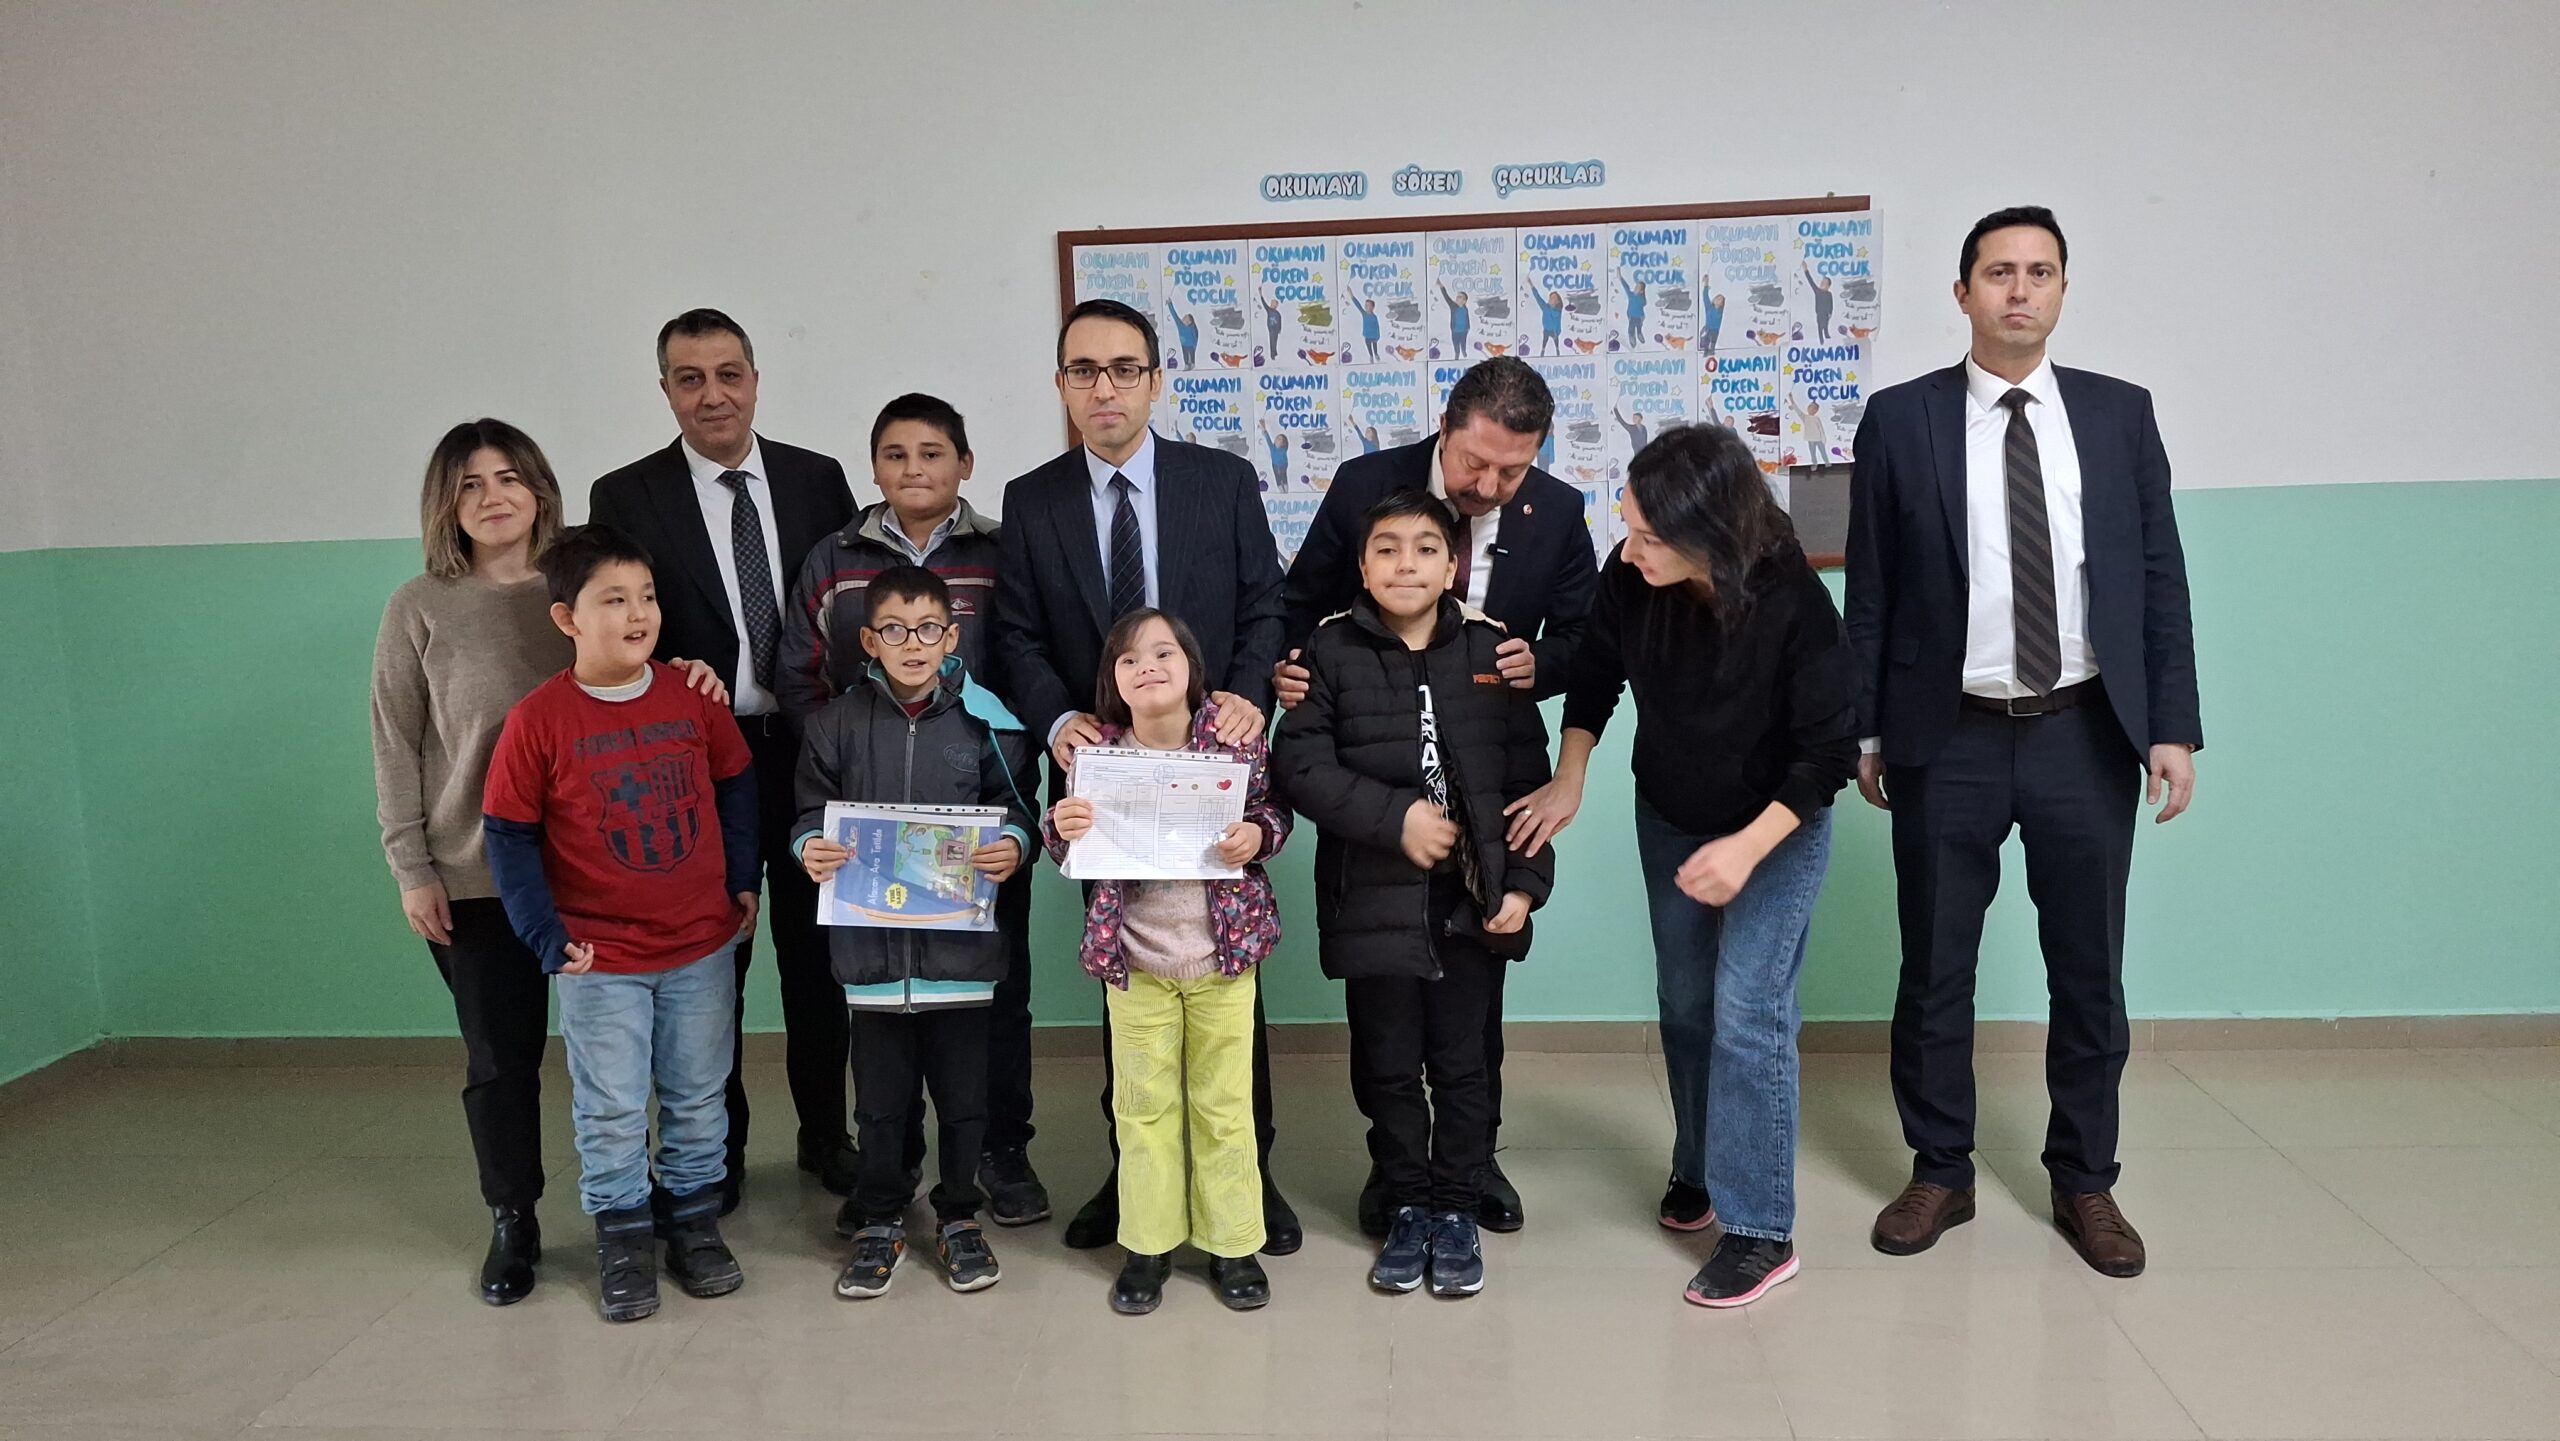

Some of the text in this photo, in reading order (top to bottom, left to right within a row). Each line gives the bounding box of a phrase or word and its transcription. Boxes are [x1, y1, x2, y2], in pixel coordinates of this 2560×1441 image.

[1264, 163, 1603, 199] OKUMAYI SÖKEN ÇOCUKLAR
[1613, 228, 1687, 247] OKUMAYI
[1705, 223, 1780, 242] OKUMAYI
[1798, 218, 1872, 238] OKUMAYI
[1343, 240, 1414, 259] OKUMAYI
[1432, 236, 1504, 255] OKUMAYI
[1523, 232, 1596, 251] OKUMAYI
[1804, 238, 1854, 259] SÖKEN
[1079, 251, 1150, 269] OKUMAYI
[1167, 248, 1237, 266] OKUMAYI
[1255, 243, 1326, 264] OKUMAYI
[1529, 251, 1578, 273] SÖKEN
[1620, 246, 1669, 268] SÖKEN
[1711, 243, 1761, 264] SÖKEN
[1262, 264, 1309, 285] SÖKEN
[1350, 259, 1398, 280] SÖKEN
[1439, 255, 1487, 276] SÖKEN
[1724, 265, 1777, 283] ÇOCUK
[1086, 270, 1134, 290] SÖKEN
[1174, 266, 1221, 287] SÖKEN
[1451, 277, 1504, 294] ÇOCUK
[1542, 273, 1594, 291] ÇOCUK
[1186, 287, 1238, 306] ÇOCUK
[1274, 285, 1326, 304] ÇOCUK
[1362, 281, 1414, 299] ÇOCUK
[1787, 344, 1860, 364] OKUMAYI
[1534, 362, 1596, 380] KUMAYI
[1613, 358, 1686, 376] OKUMAYI
[1704, 355, 1777, 373] OKUMAYI
[1259, 373, 1329, 391] OKUMAYI
[1346, 370, 1416, 388] OKUMAYI
[1711, 374, 1760, 394] SÖKEN
[1793, 364, 1843, 385] SÖKEN
[1173, 376, 1242, 394] OKUMAYI
[1619, 376, 1668, 397] SÖKEN
[1179, 394, 1226, 414] SÖKEN
[1265, 391, 1312, 412] SÖKEN
[1353, 388, 1400, 408] SÖKEN
[1723, 395, 1777, 413] ÇOCUK
[1365, 409, 1417, 427] ÇOCUK
[1554, 402, 1596, 419] OCUK
[1192, 416, 1243, 433] ÇOCUK
[1278, 413, 1329, 430] ÇOCUK
[870, 857, 881, 874] Ara
[867, 876, 880, 905] Afacan
